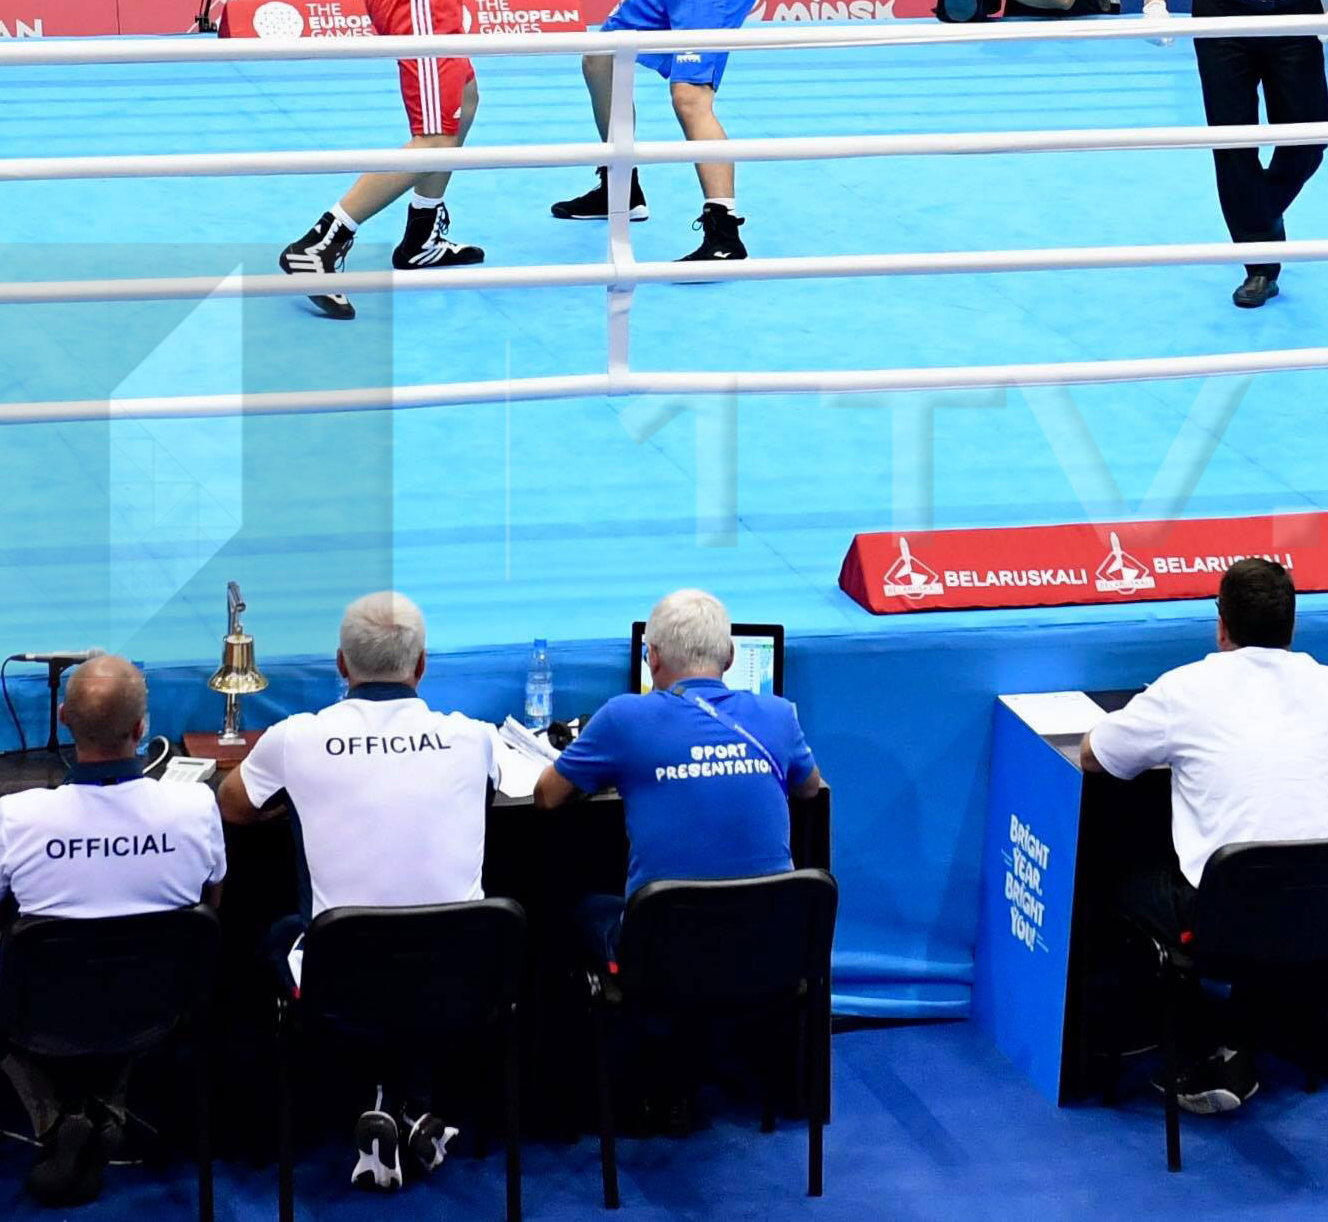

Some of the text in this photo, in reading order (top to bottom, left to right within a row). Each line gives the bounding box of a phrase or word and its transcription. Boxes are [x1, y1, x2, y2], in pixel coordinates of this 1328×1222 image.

[305, 2, 341, 16] THE
[478, 10, 579, 25] EUROPEAN
[944, 569, 1088, 587] BELARUSKALI
[326, 733, 452, 756] OFFICIAL
[690, 742, 747, 761] SPORT
[655, 759, 772, 782] PRESENTATIO
[45, 832, 176, 860] OFFICIAL
[1009, 813, 1050, 870] BRIGHT
[1005, 870, 1046, 928] BRIGHT
[1010, 900, 1037, 953] YOU!
